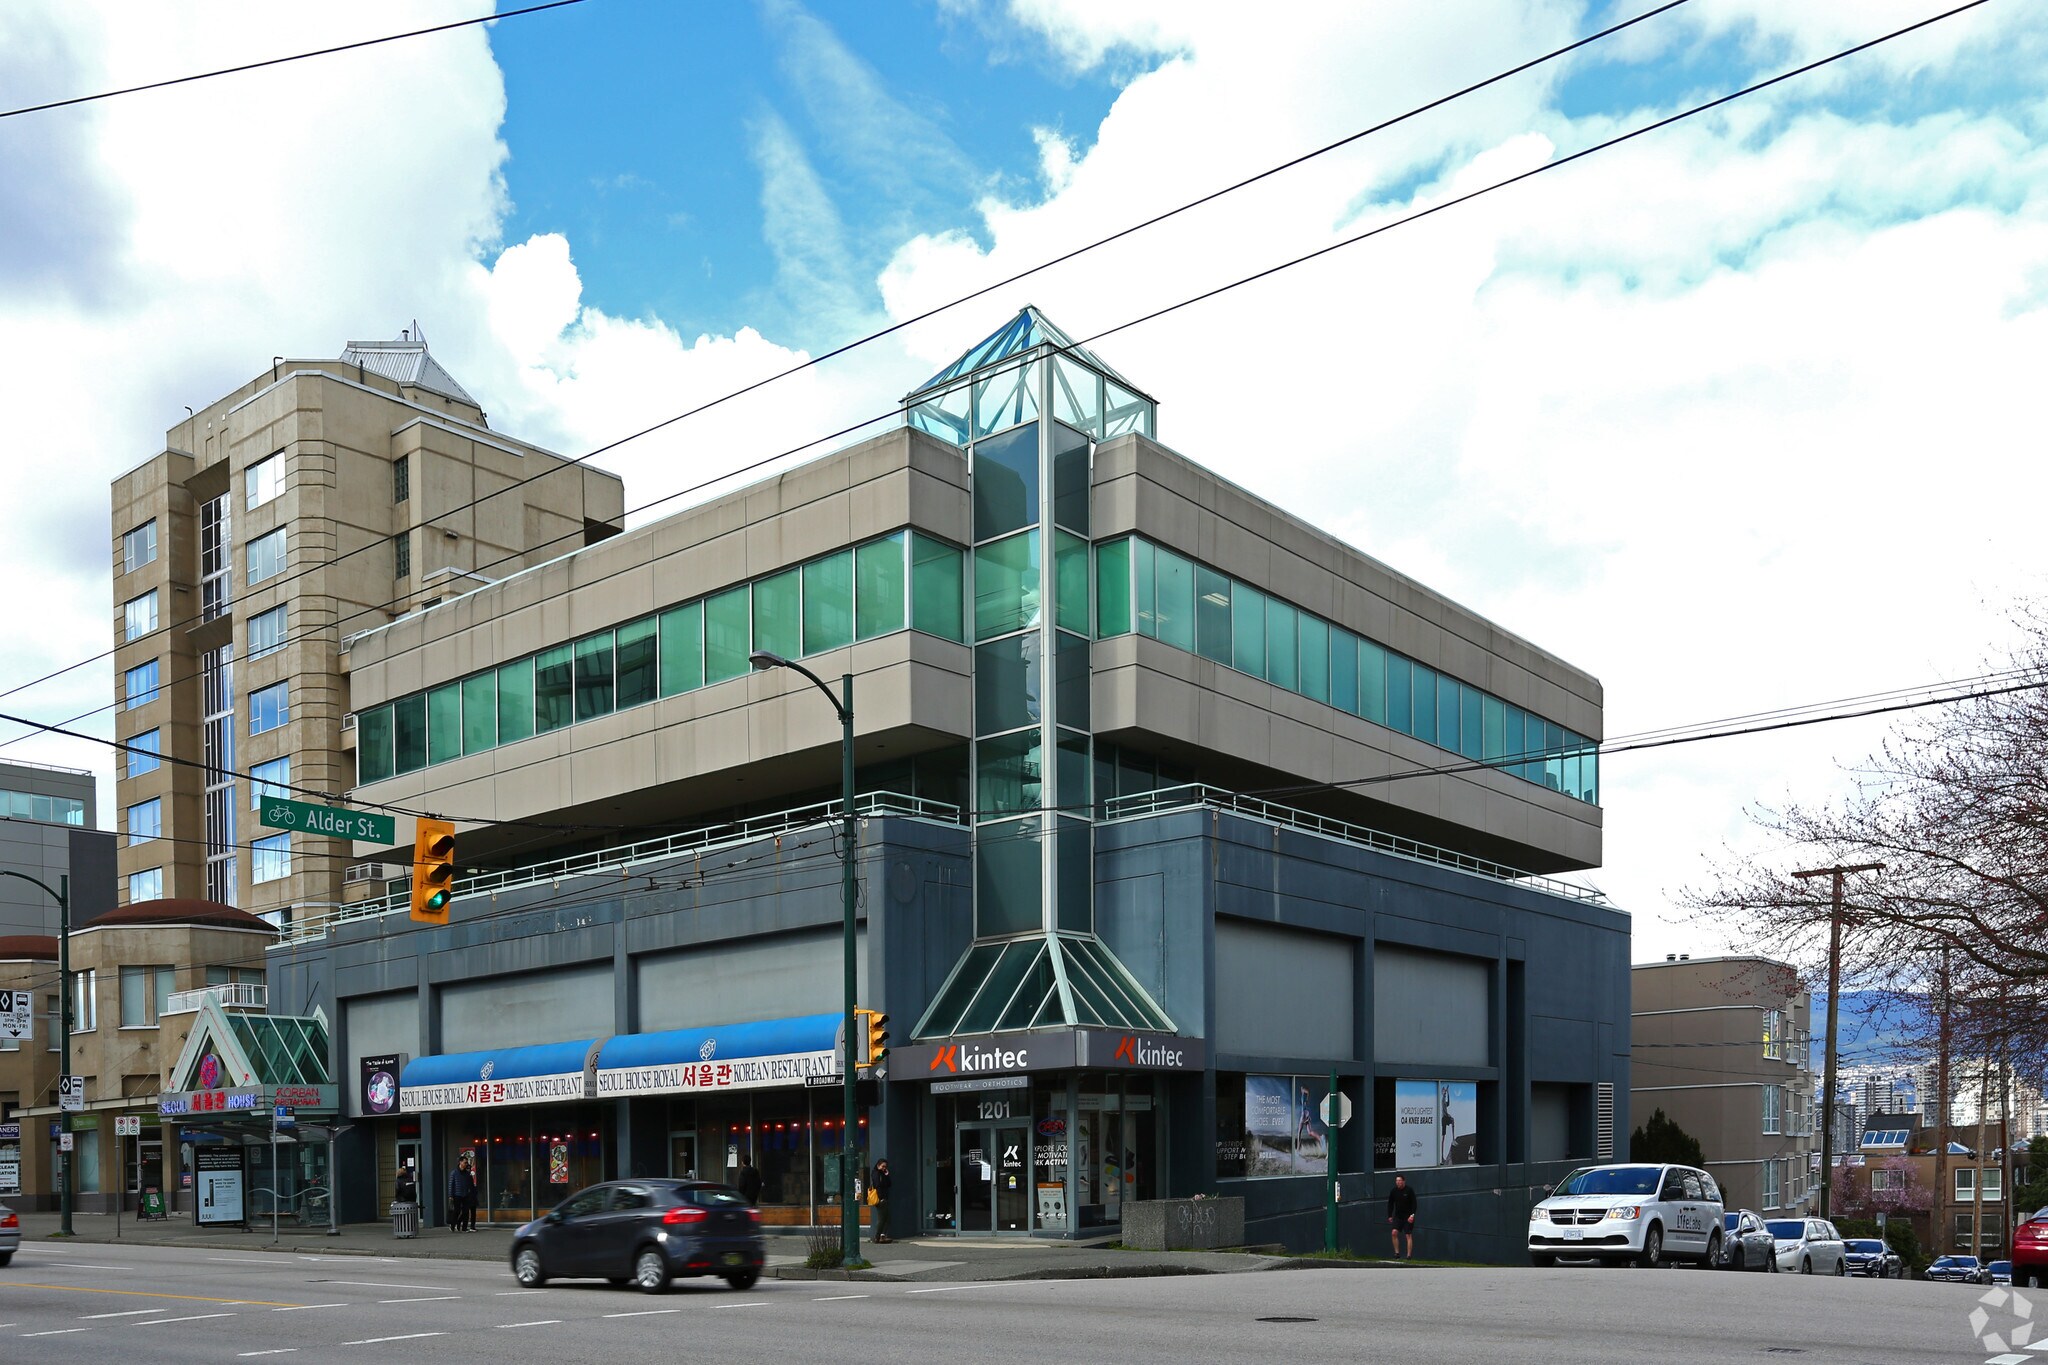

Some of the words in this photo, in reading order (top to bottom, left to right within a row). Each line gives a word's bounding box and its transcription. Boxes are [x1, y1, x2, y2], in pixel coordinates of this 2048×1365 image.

[306, 809, 353, 834] Alder
[357, 817, 381, 839] St.
[961, 1044, 1027, 1072] kintec
[1137, 1037, 1183, 1067] kintec
[599, 1073, 625, 1092] SEOUL
[626, 1071, 652, 1090] HOUSE
[653, 1069, 681, 1088] ROYAL
[681, 1063, 732, 1087] 서울관
[733, 1060, 770, 1083] KOREAN
[771, 1056, 833, 1081] RESTAURANT
[813, 1076, 836, 1085] BROADWAY
[276, 1087, 319, 1097] KOREAN
[401, 1091, 421, 1107] SEOUL
[421, 1088, 443, 1105] HOUSE
[444, 1087, 466, 1104] ROYAL
[466, 1083, 505, 1103] 서울관
[506, 1080, 534, 1099] KOREAN
[535, 1076, 583, 1097] RESTAURANT
[935, 1083, 972, 1091] FOOTWEAR
[982, 1079, 1023, 1088] ORTHOTICS
[161, 1100, 188, 1114] SEOUL
[228, 1093, 257, 1108] HOUSE
[1256, 1095, 1265, 1104] THE
[1266, 1095, 1281, 1104] MOST
[977, 1101, 1010, 1119] 1201
[1252, 1106, 1286, 1115] COMFORTABLE
[1417, 1106, 1433, 1115] LIGHTEST
[1408, 1116, 1420, 1125] KNEE
[1420, 1116, 1433, 1125] BRACE
